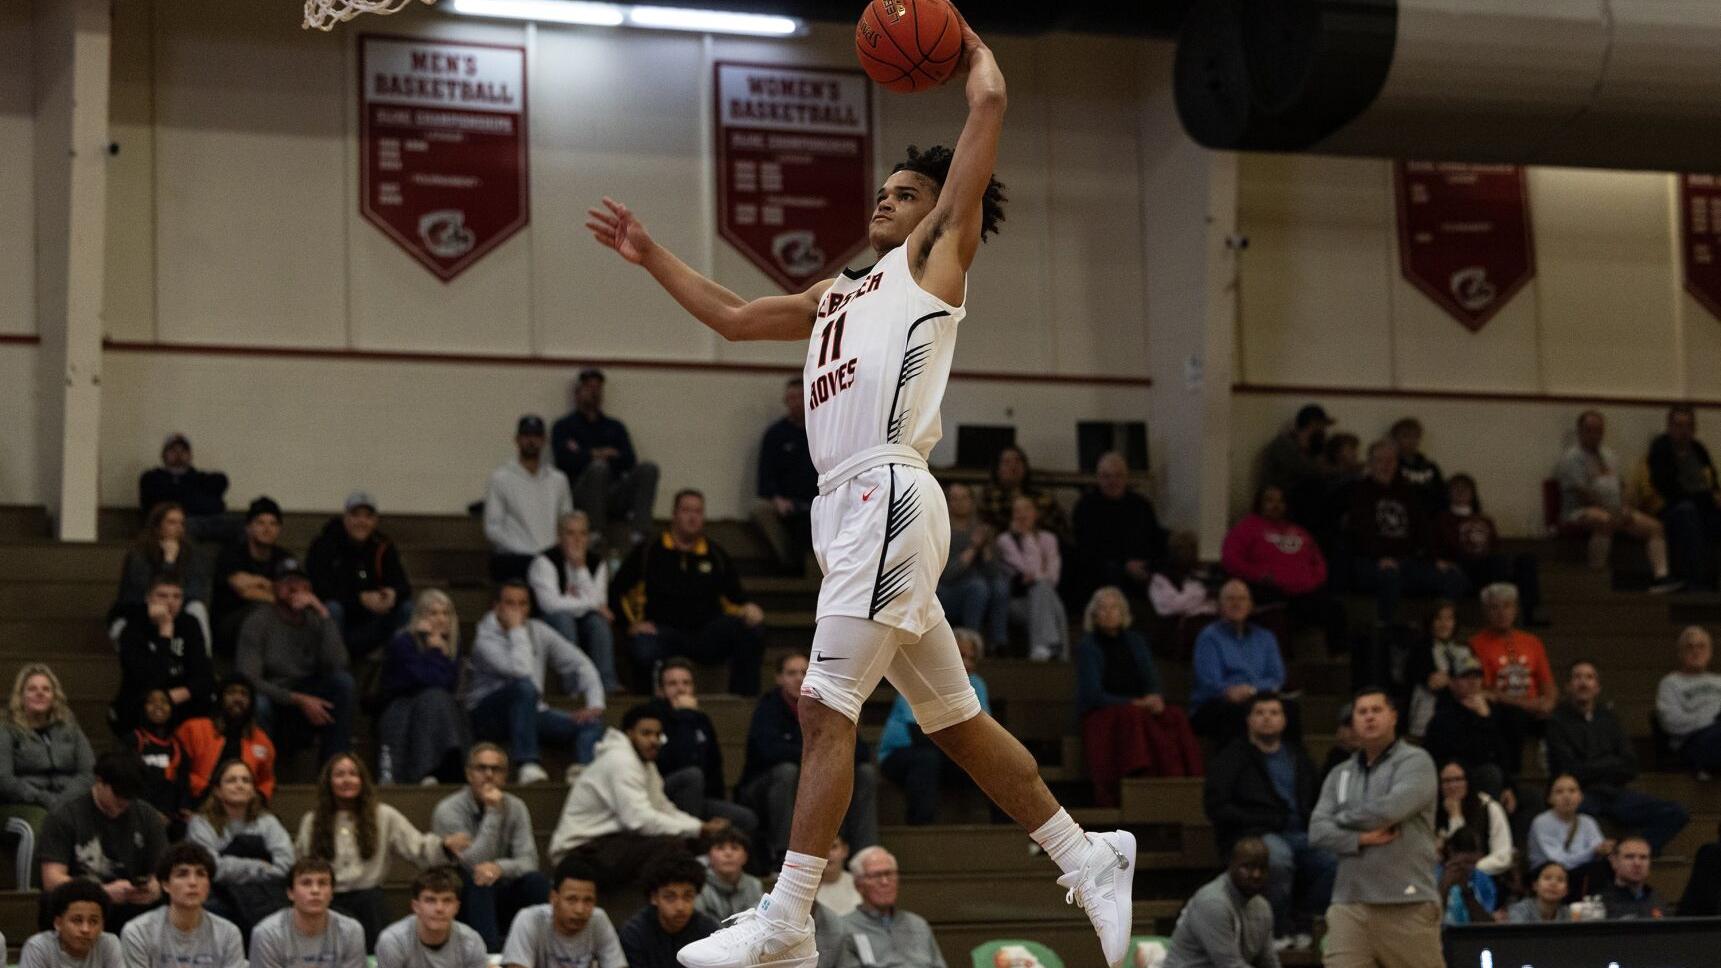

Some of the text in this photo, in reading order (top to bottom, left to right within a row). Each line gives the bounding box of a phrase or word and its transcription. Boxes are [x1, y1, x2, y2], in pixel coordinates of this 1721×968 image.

[411, 51, 477, 76] MEN'S
[375, 72, 514, 104] BASKETBALL
[748, 77, 839, 100] WOMEN'S
[730, 98, 858, 126] BASKETBALL
[818, 311, 848, 368] 11
